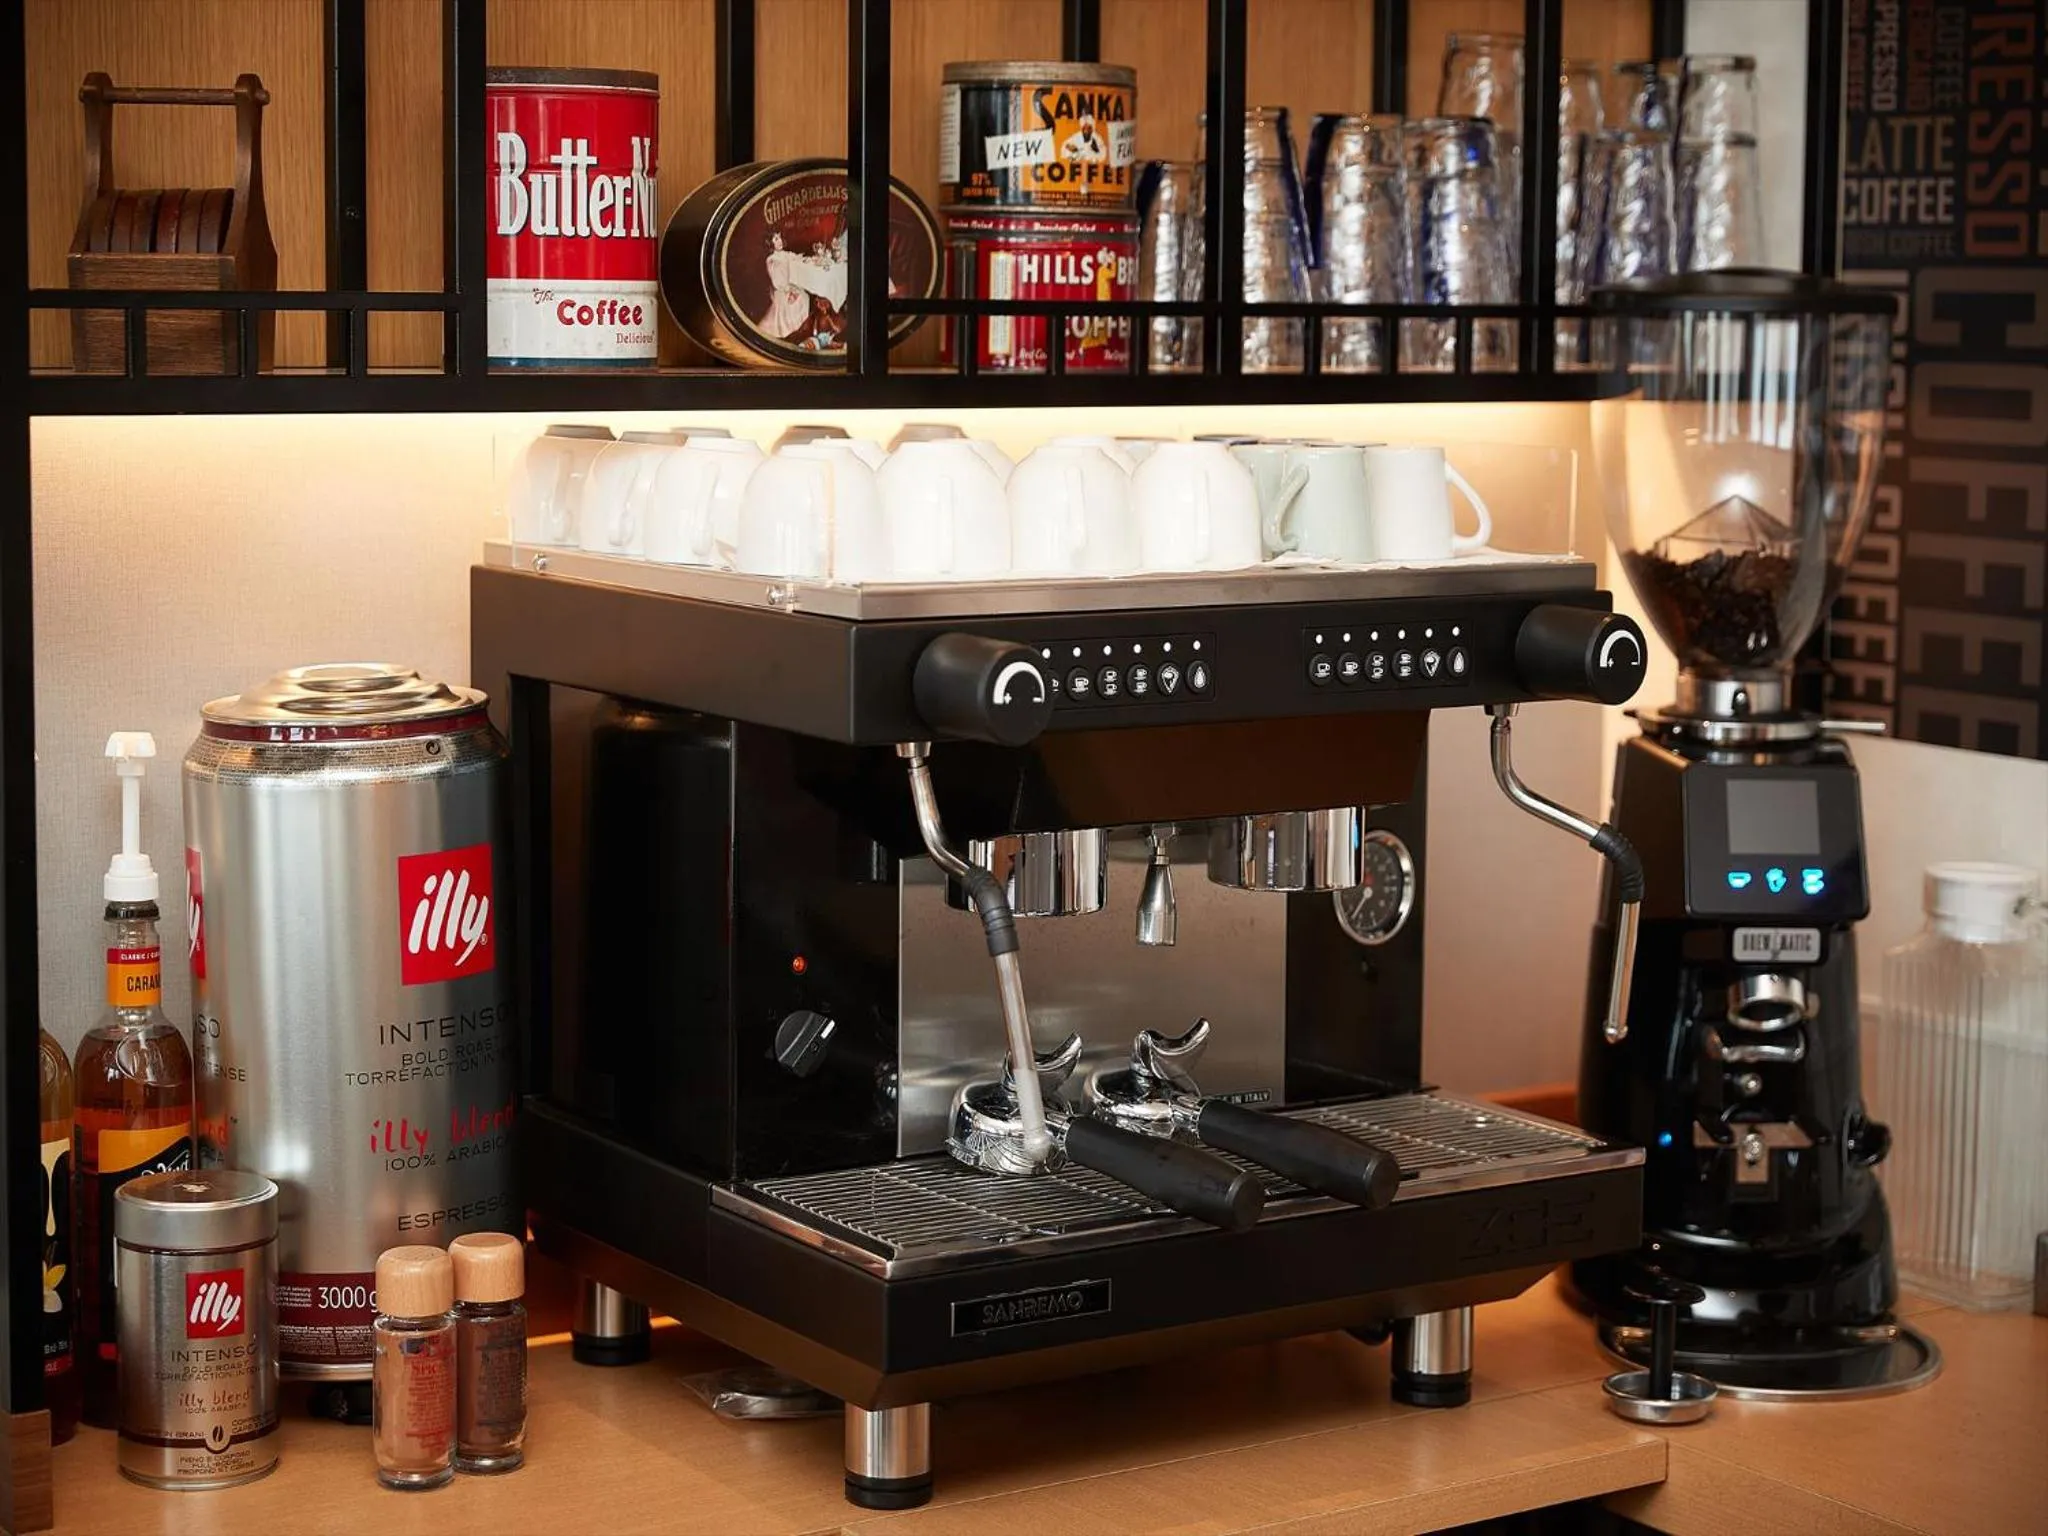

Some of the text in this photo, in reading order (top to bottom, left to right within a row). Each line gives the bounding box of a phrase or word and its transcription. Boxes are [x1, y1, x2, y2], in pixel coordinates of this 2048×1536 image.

[1033, 86, 1126, 134] SANKA
[1963, 0, 2036, 257] RESSO
[997, 139, 1043, 161] NEW
[1032, 163, 1125, 186] COFFEE
[1018, 254, 1095, 285] HILLS
[556, 298, 644, 326] Coffee
[1901, 267, 2048, 762] COFFEE
[408, 869, 489, 967] illy
[379, 1001, 509, 1045] INTENSO
[402, 1047, 449, 1067] BOLD
[1244, 1092, 1270, 1103] ITALY
[370, 1090, 518, 1158] illy blend
[385, 1152, 437, 1172] 100%
[189, 1281, 242, 1333] illy
[317, 1285, 367, 1310] 3000
[982, 1290, 1084, 1325] SANREMO
[171, 1343, 258, 1363] INTENSO
[184, 1365, 212, 1374] BOLD
[179, 1388, 251, 1409] illy blend
